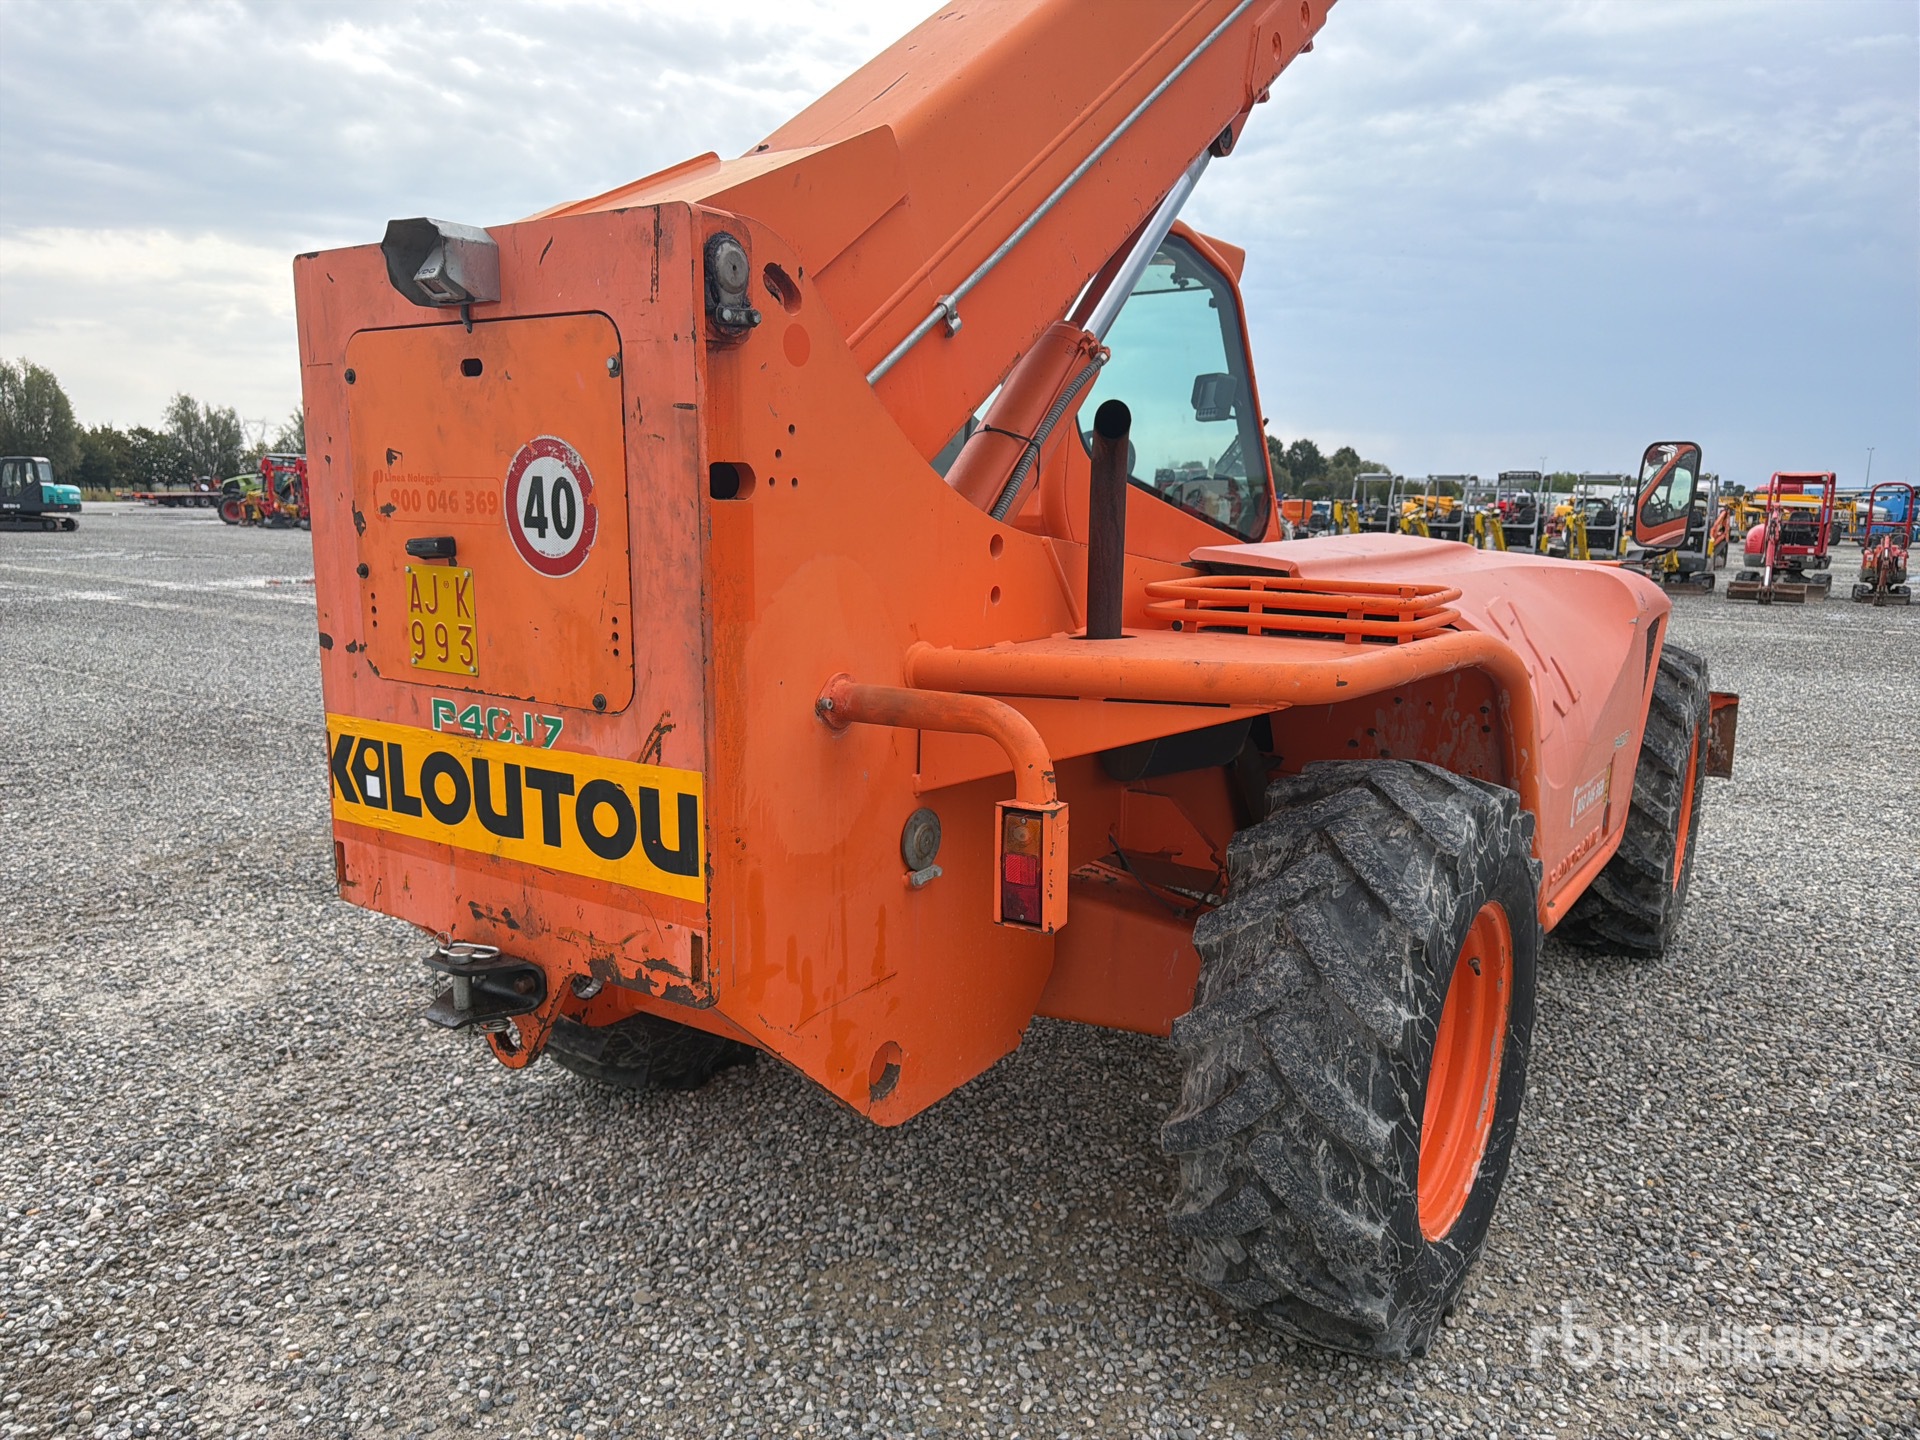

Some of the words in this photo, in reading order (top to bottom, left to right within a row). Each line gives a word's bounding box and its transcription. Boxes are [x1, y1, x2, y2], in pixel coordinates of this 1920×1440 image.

[384, 473, 406, 482] Linea
[407, 473, 442, 486] Noleggio
[426, 489, 459, 513] 046
[464, 490, 498, 515] 369
[523, 474, 576, 540] 40
[411, 619, 474, 666] 993
